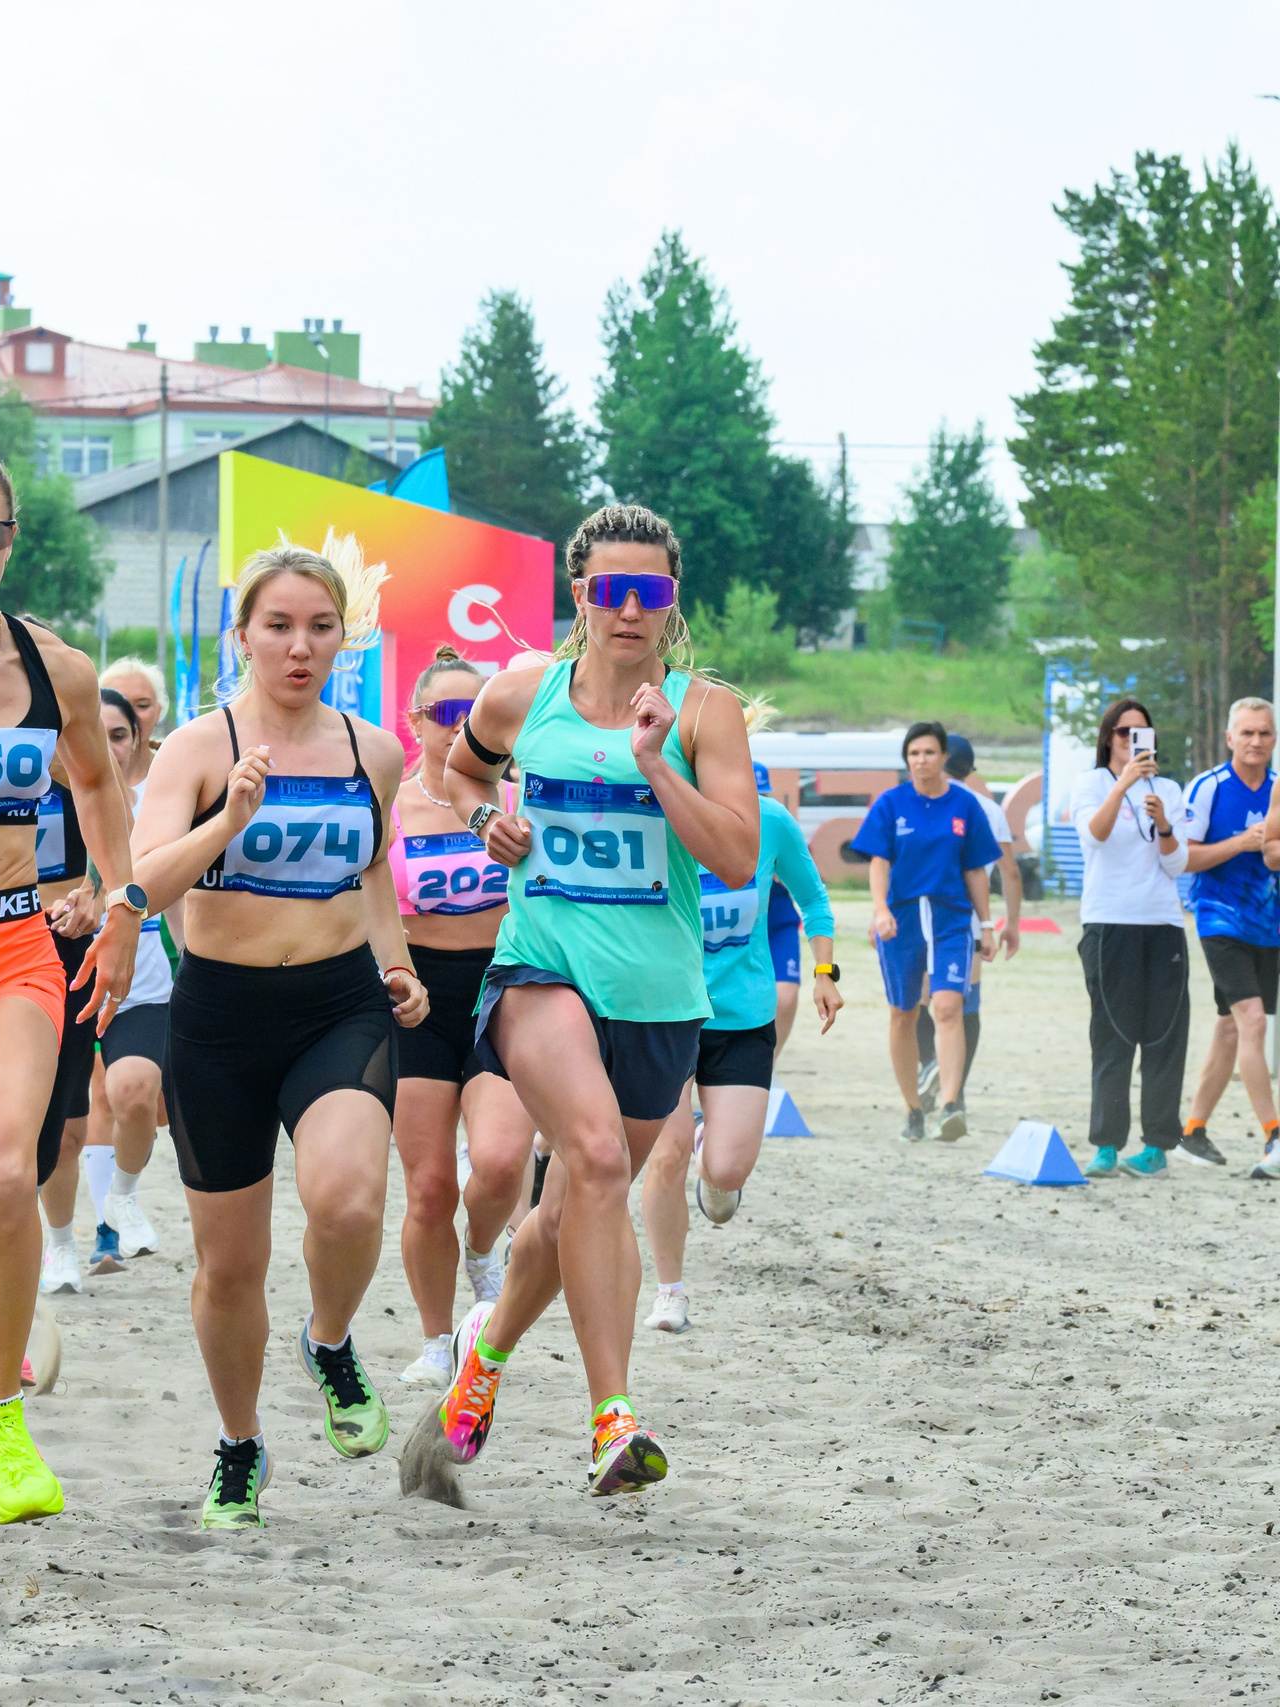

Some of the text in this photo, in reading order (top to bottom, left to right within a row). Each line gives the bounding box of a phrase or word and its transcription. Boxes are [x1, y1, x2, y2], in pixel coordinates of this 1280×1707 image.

[242, 821, 360, 864] 074
[542, 825, 645, 870] 081
[417, 863, 510, 900] 202
[582, 891, 617, 899] ТРУДОВЫХ
